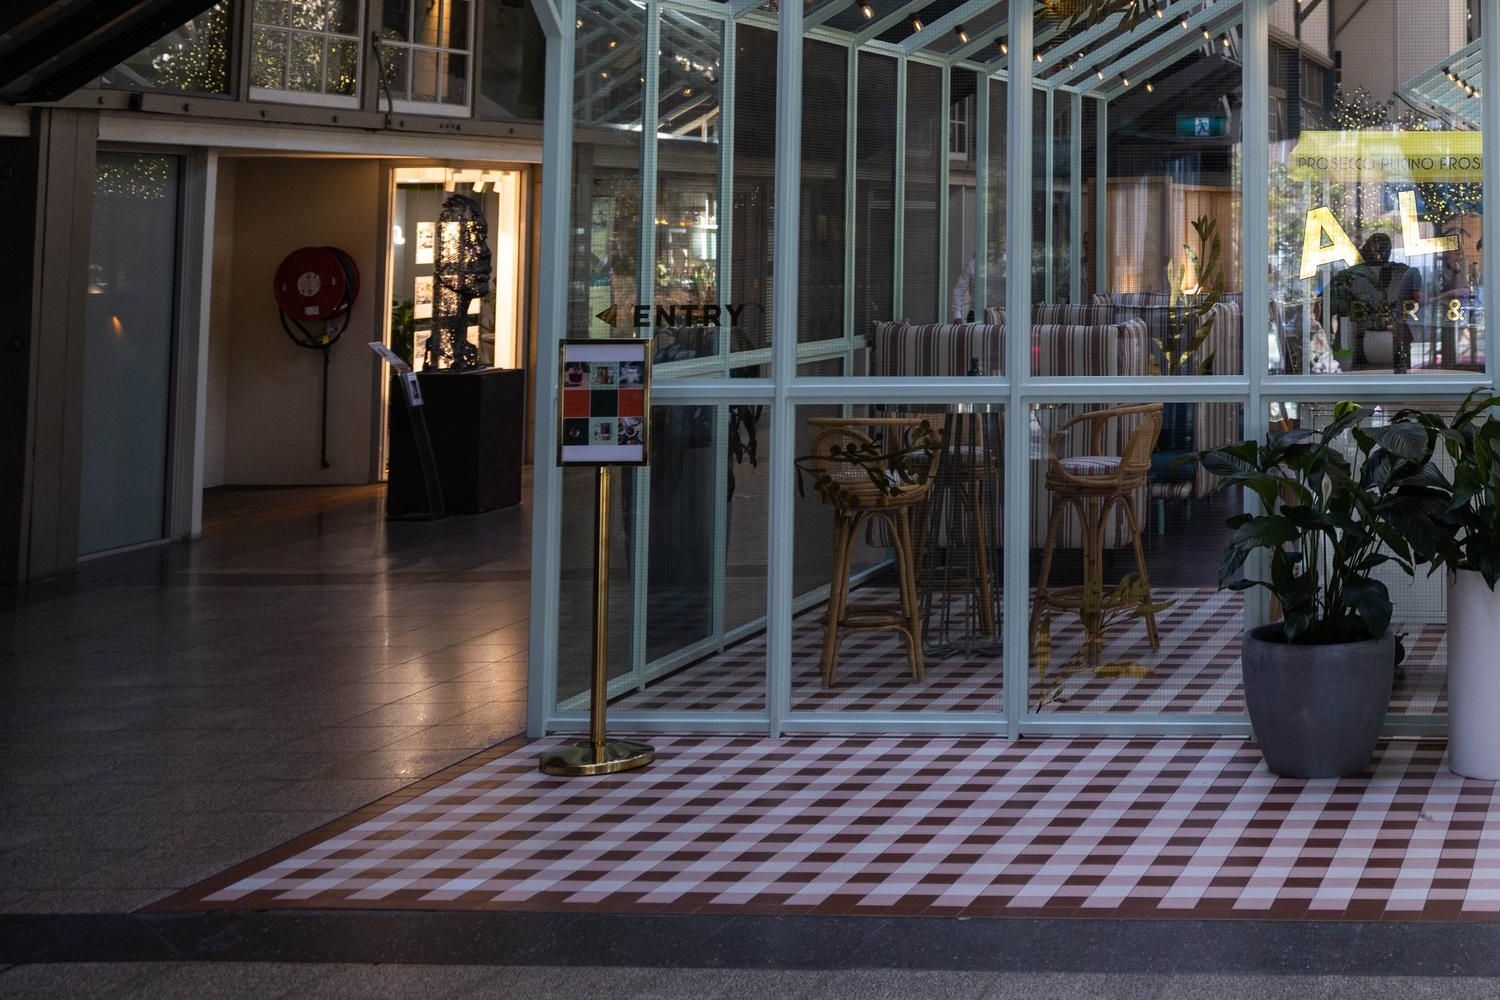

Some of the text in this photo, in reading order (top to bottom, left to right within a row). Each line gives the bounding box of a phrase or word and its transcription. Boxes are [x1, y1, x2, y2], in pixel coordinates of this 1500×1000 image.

[1298, 157, 1375, 171] PROSECCO
[1381, 157, 1434, 171] PUCINO
[634, 303, 745, 327] ENTRY
[1350, 299, 1420, 322] BAR
[1446, 298, 1466, 322] &
